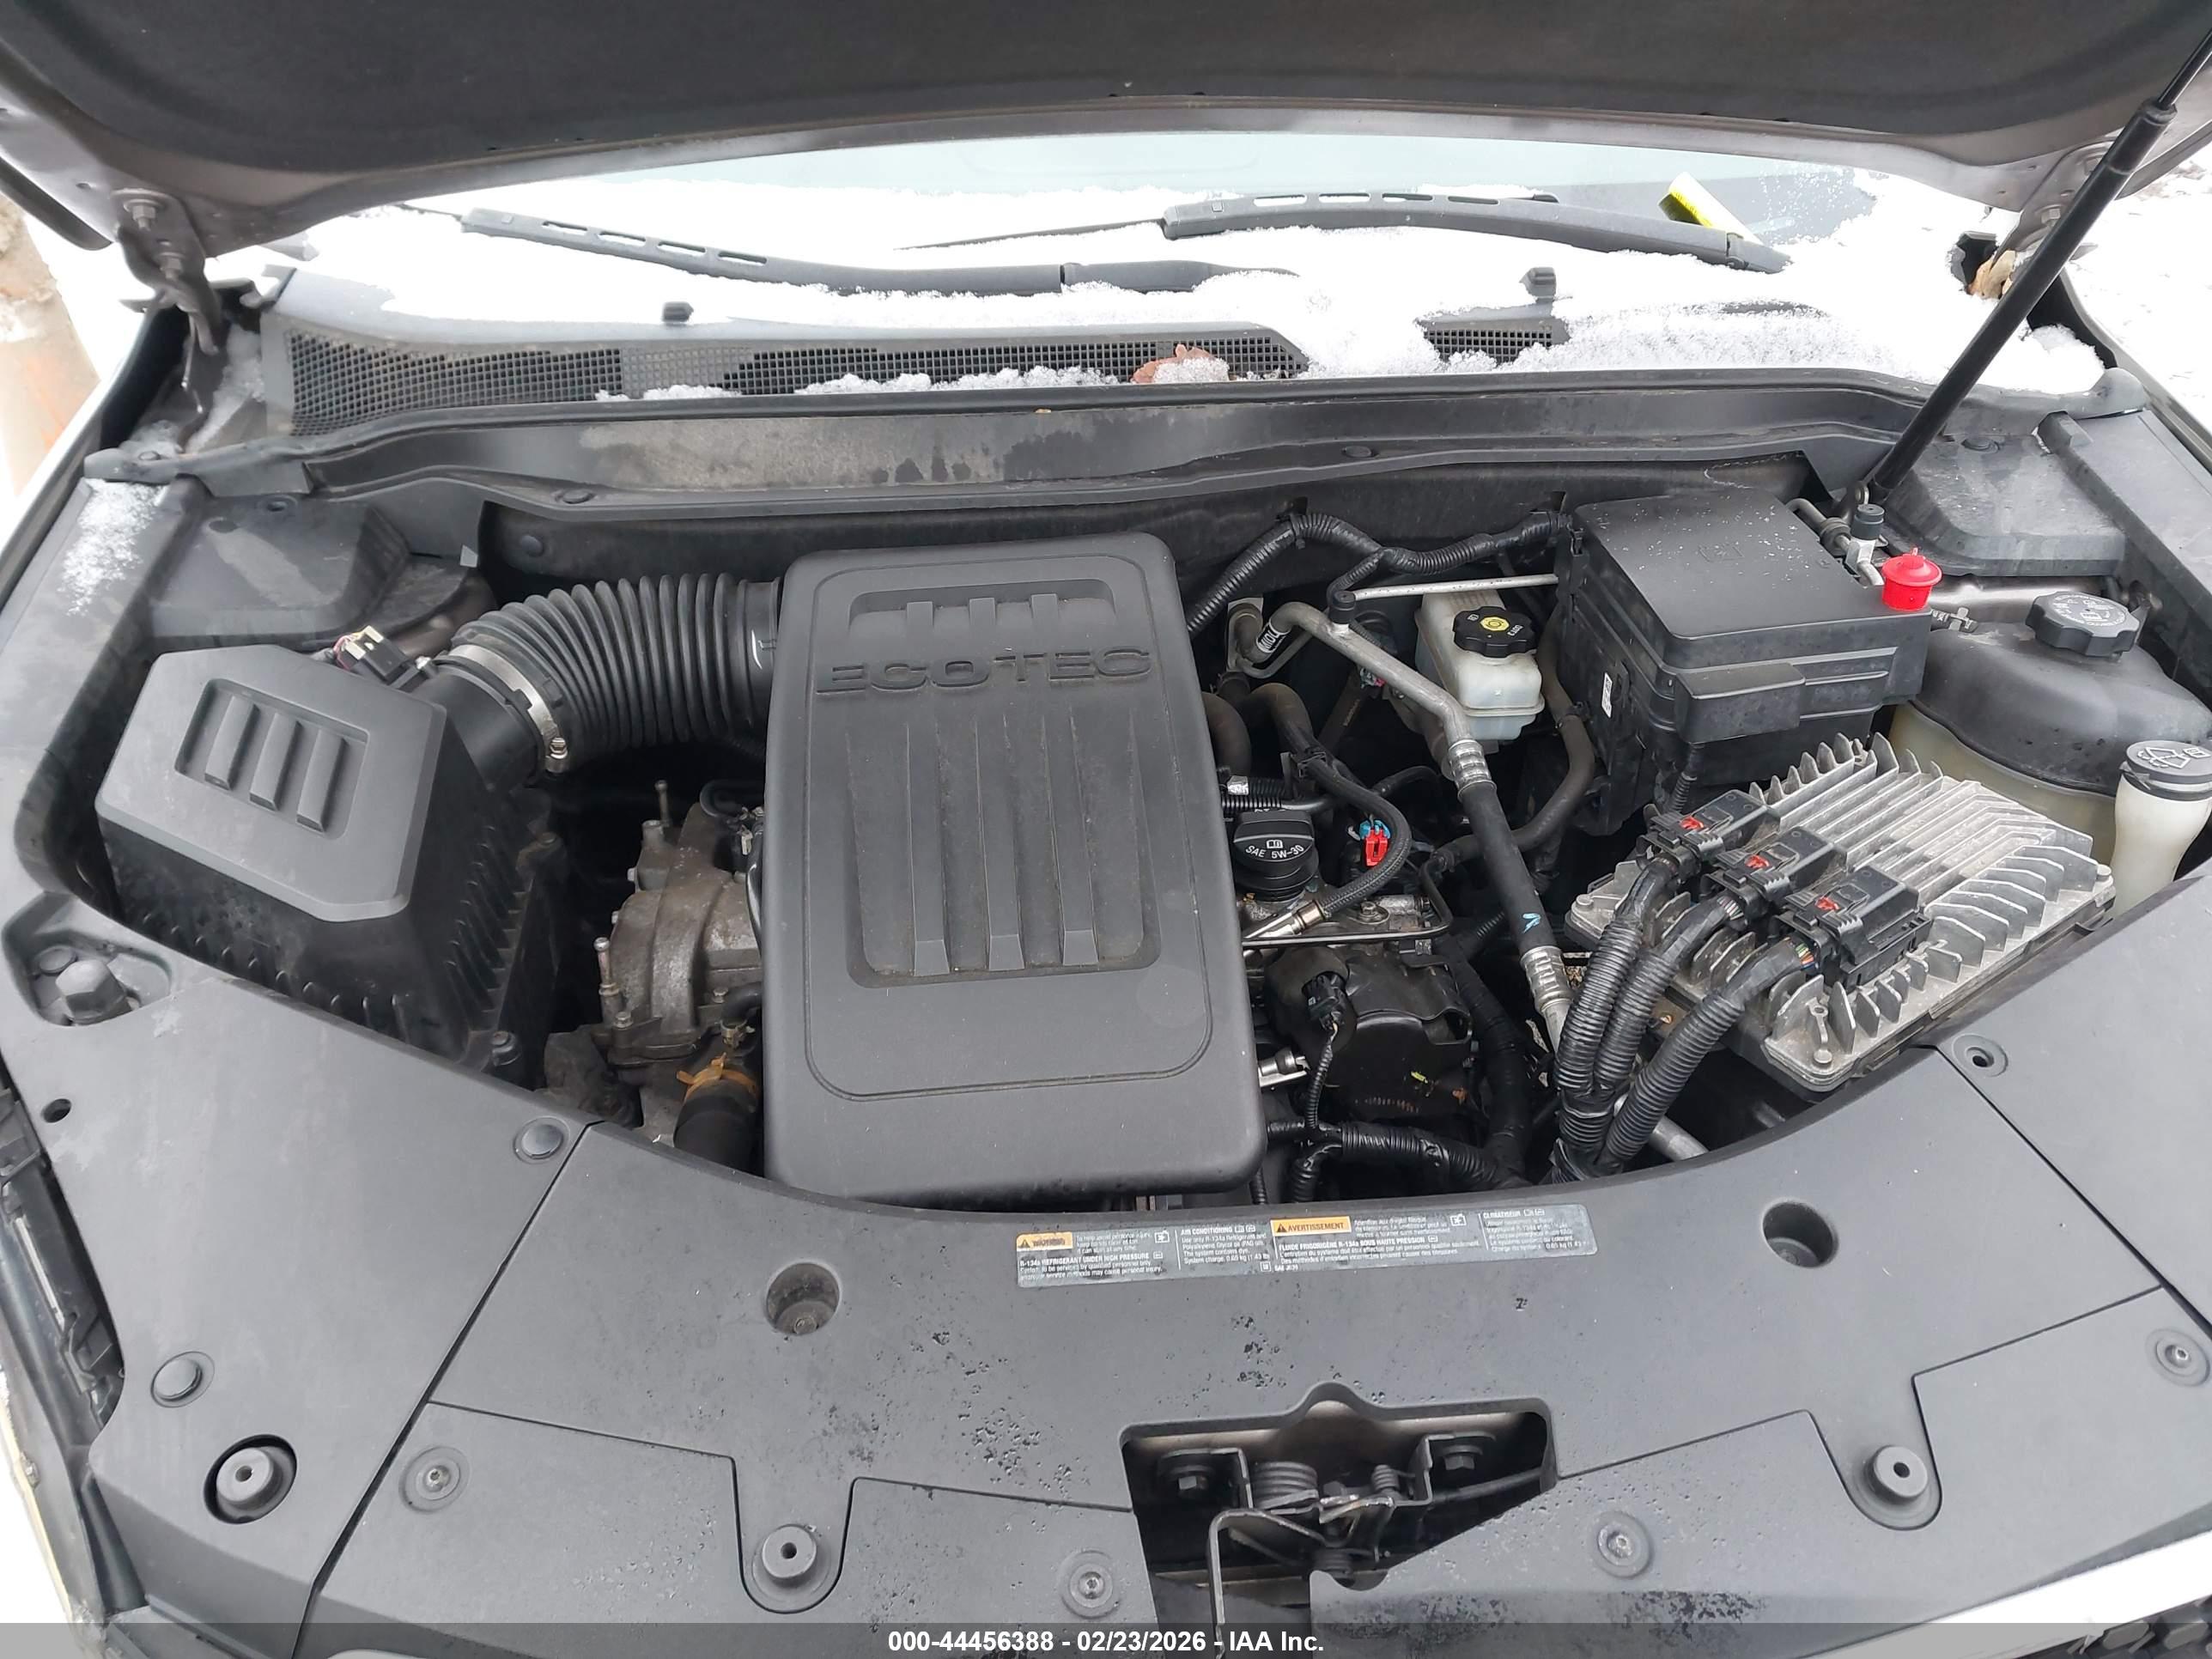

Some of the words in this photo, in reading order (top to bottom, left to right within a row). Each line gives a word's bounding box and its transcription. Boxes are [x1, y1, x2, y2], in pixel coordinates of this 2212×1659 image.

[816, 645, 1151, 694] ECOTEC
[1245, 845, 1267, 858] SAE
[1271, 844, 1304, 860] 5W-30
[1192, 1226, 1232, 1235] CONDITIONING
[1288, 1223, 1344, 1231] AVERTISSEMENT
[1042, 1257, 1081, 1266] REFRIGERANT
